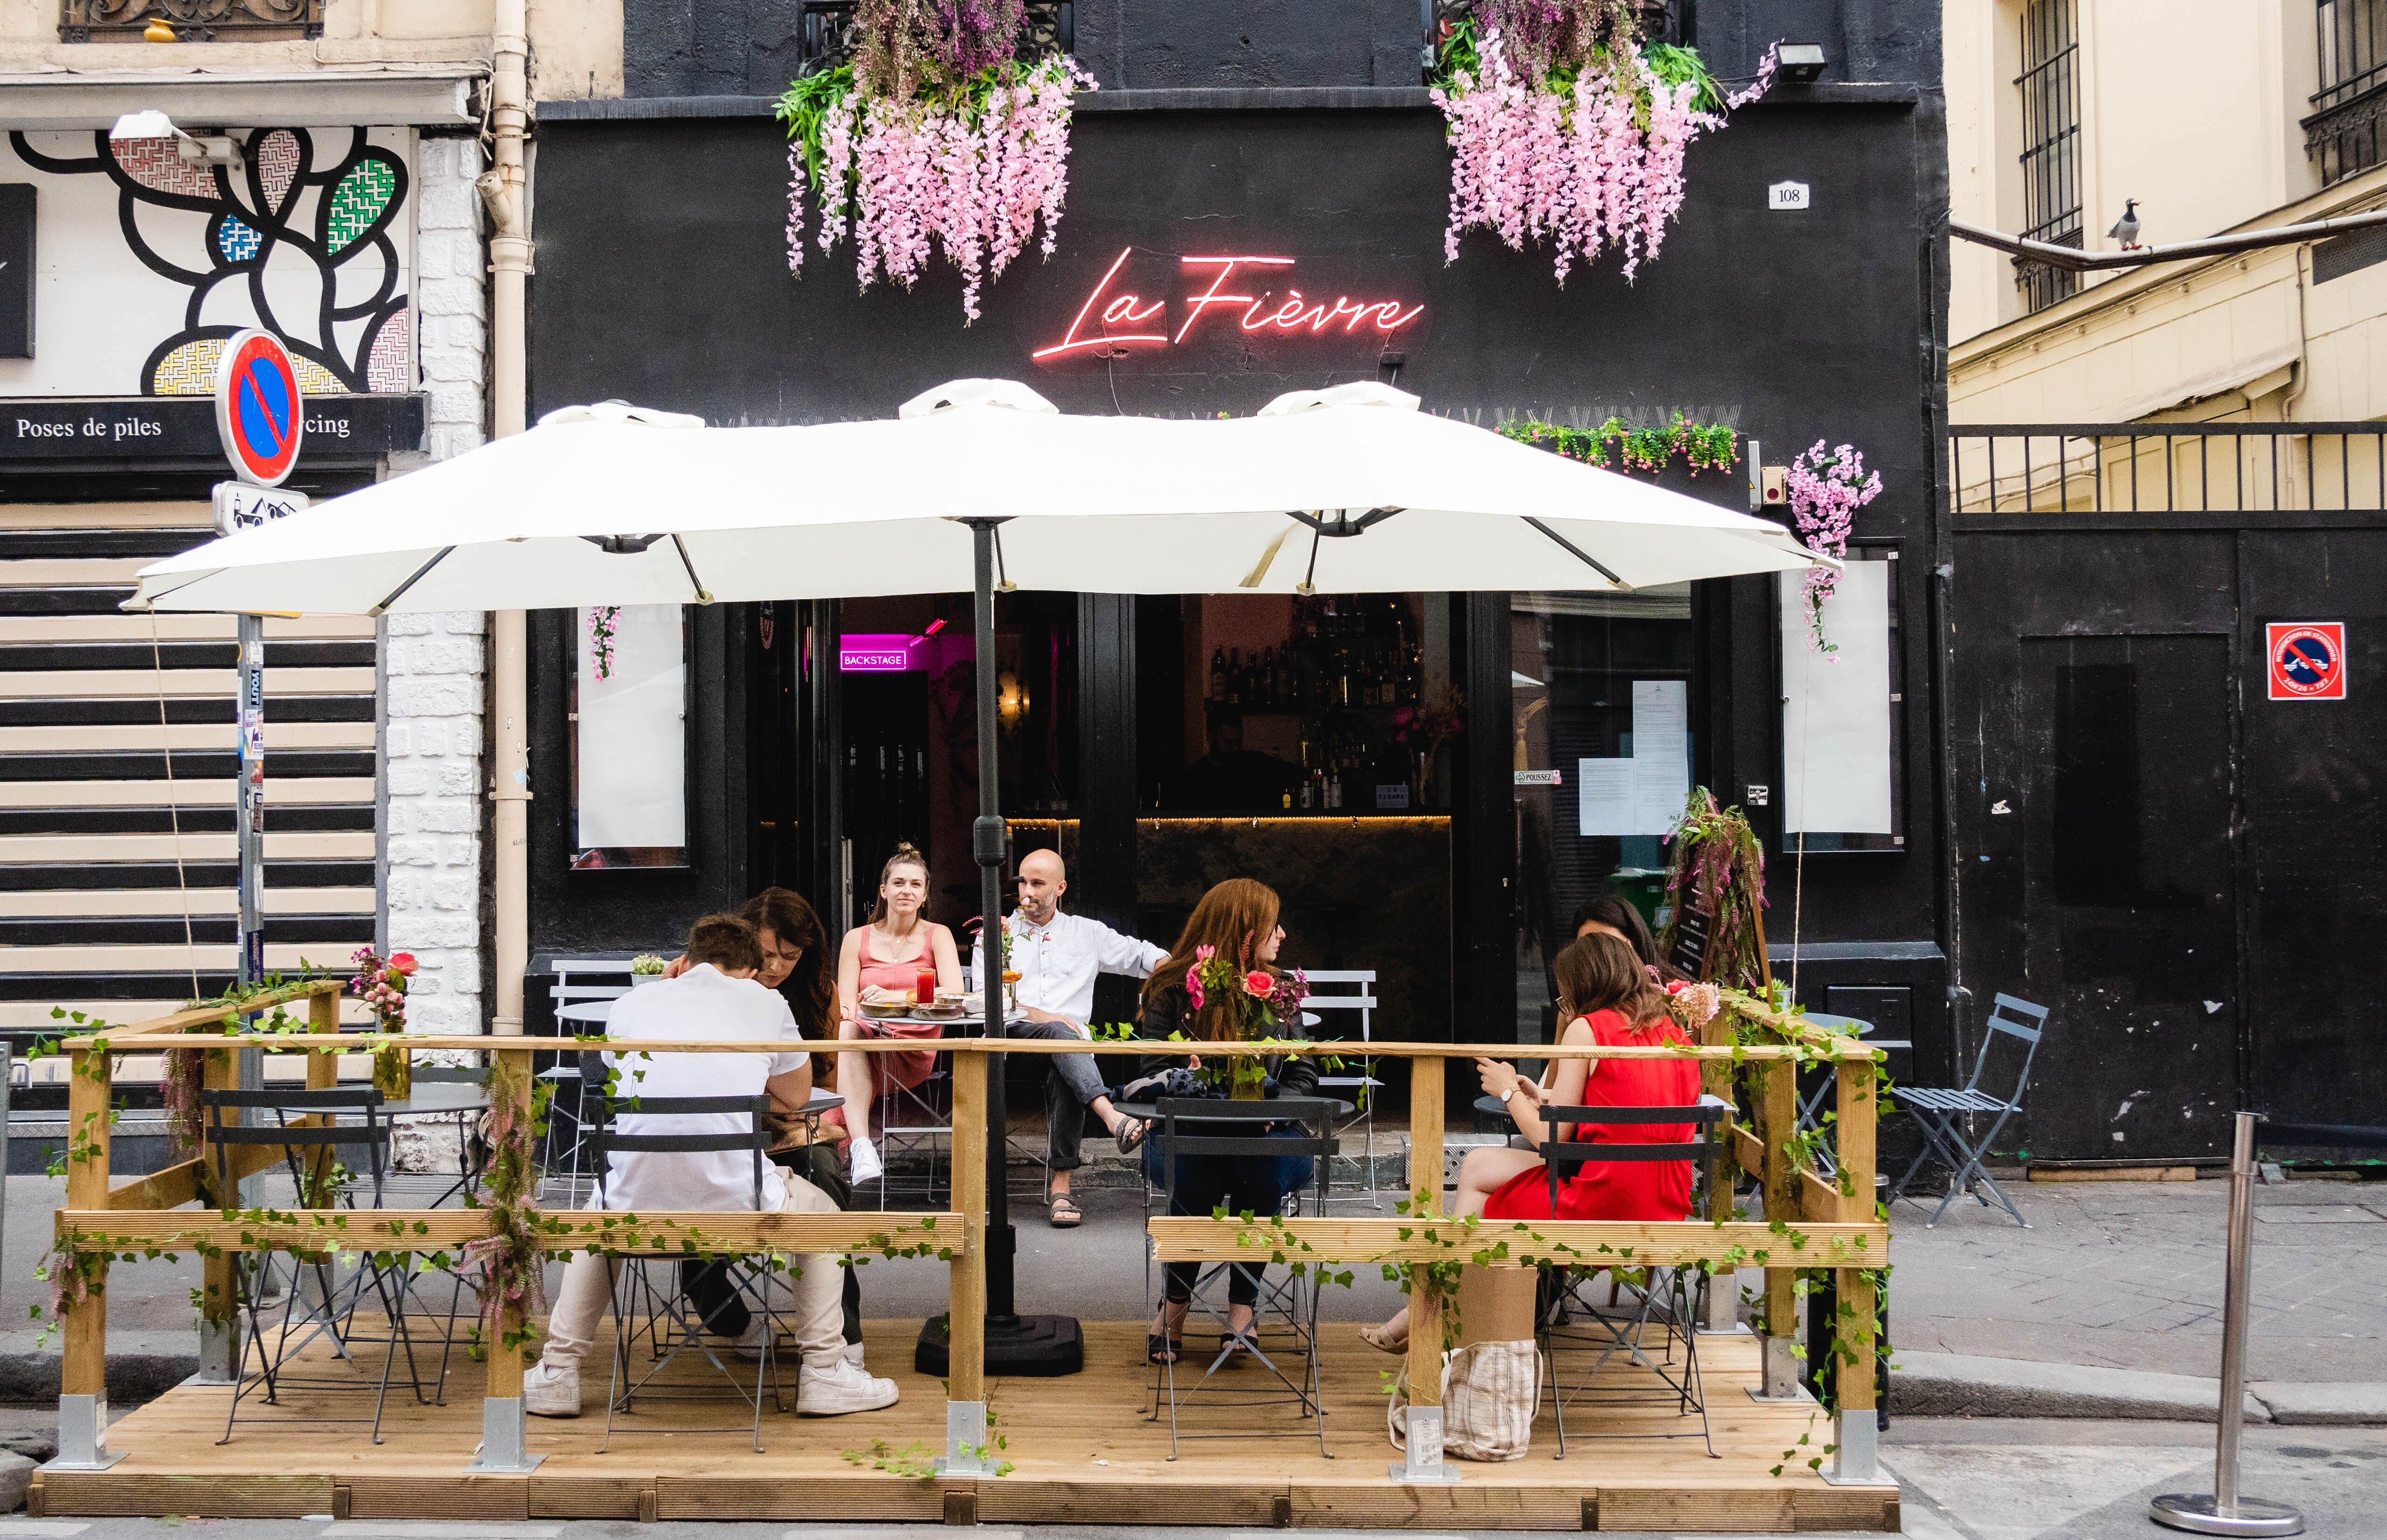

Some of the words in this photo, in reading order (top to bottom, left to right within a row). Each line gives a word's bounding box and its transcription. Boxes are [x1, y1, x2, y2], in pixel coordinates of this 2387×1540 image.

[1779, 189, 1800, 202] 108
[1033, 247, 1168, 358] La
[1174, 256, 1424, 344] Fièvre
[16, 419, 75, 437] Poses
[83, 417, 107, 436] de
[114, 417, 162, 441] piles
[303, 414, 350, 438] cing
[845, 656, 902, 665] BACKSTAGE
